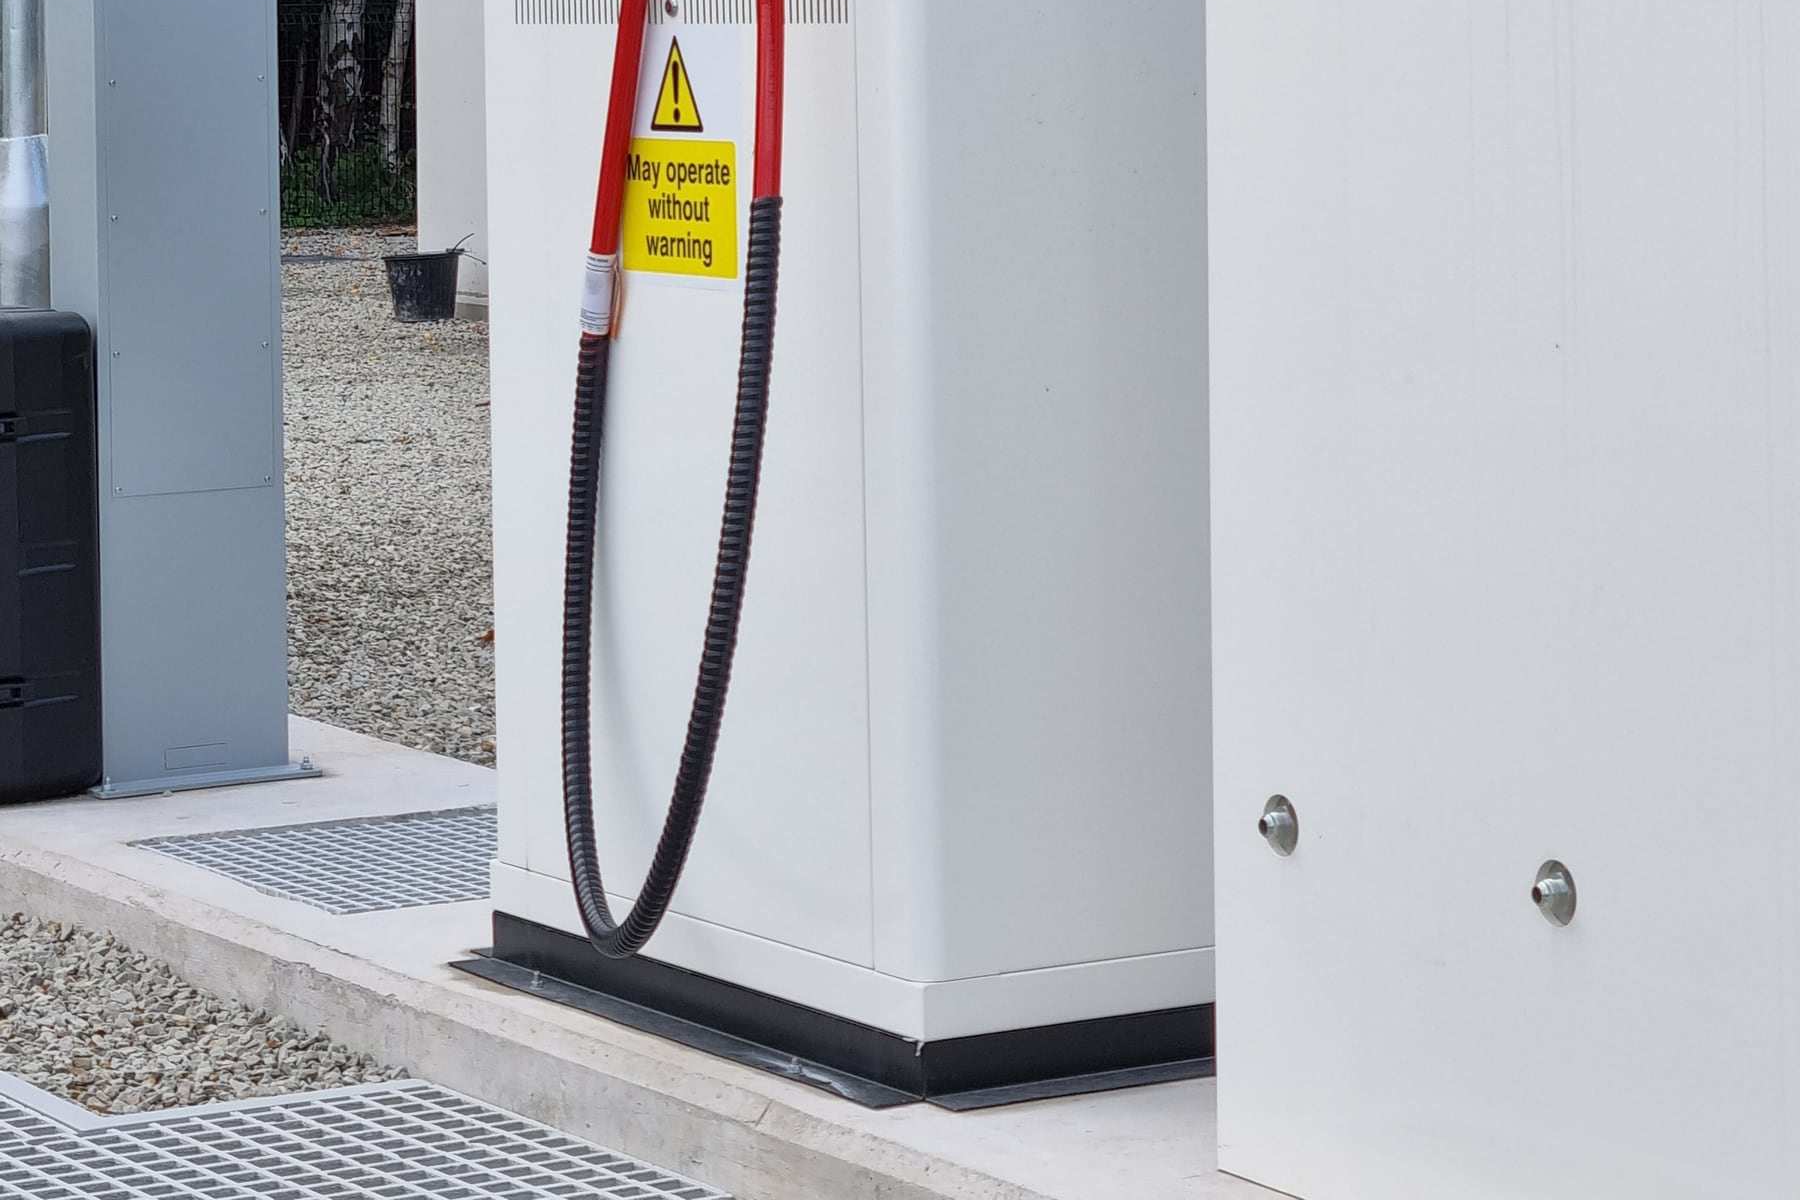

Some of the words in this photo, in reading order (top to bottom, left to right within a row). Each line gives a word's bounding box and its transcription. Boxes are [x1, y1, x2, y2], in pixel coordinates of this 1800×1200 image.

[627, 153, 661, 190] May
[666, 159, 730, 190] operate
[648, 192, 710, 222] without
[646, 231, 712, 267] warning
